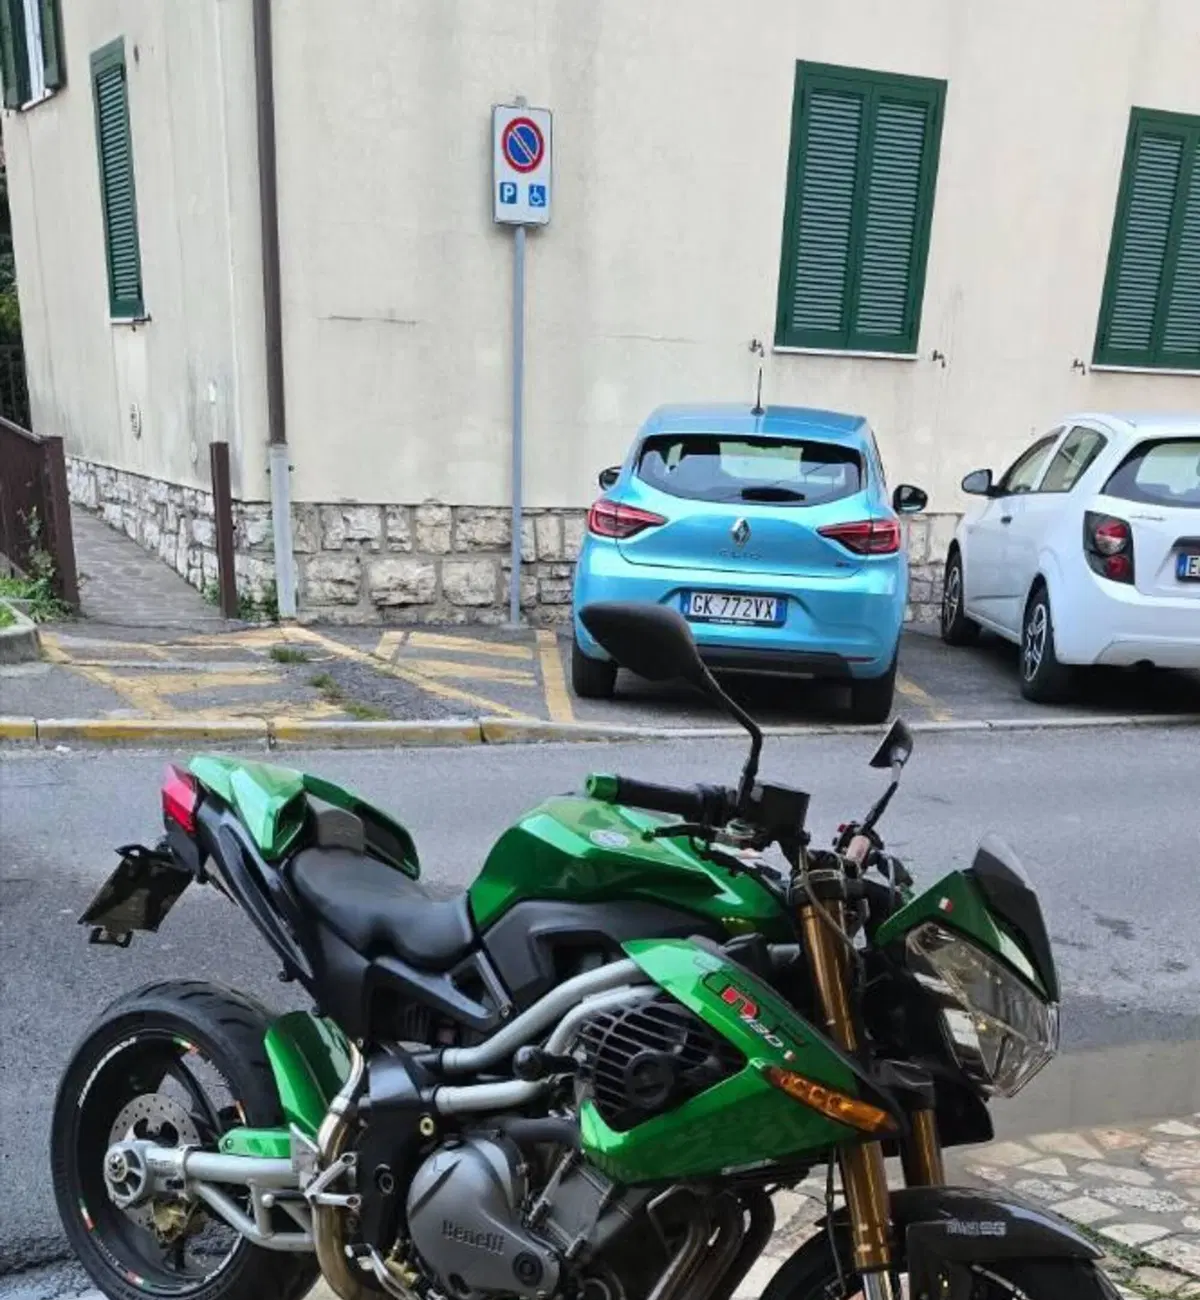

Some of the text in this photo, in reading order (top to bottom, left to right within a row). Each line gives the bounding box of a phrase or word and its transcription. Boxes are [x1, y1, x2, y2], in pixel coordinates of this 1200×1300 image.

[503, 184, 516, 202] P
[693, 594, 773, 619] GK 772VX
[441, 1219, 505, 1255] Benelli
